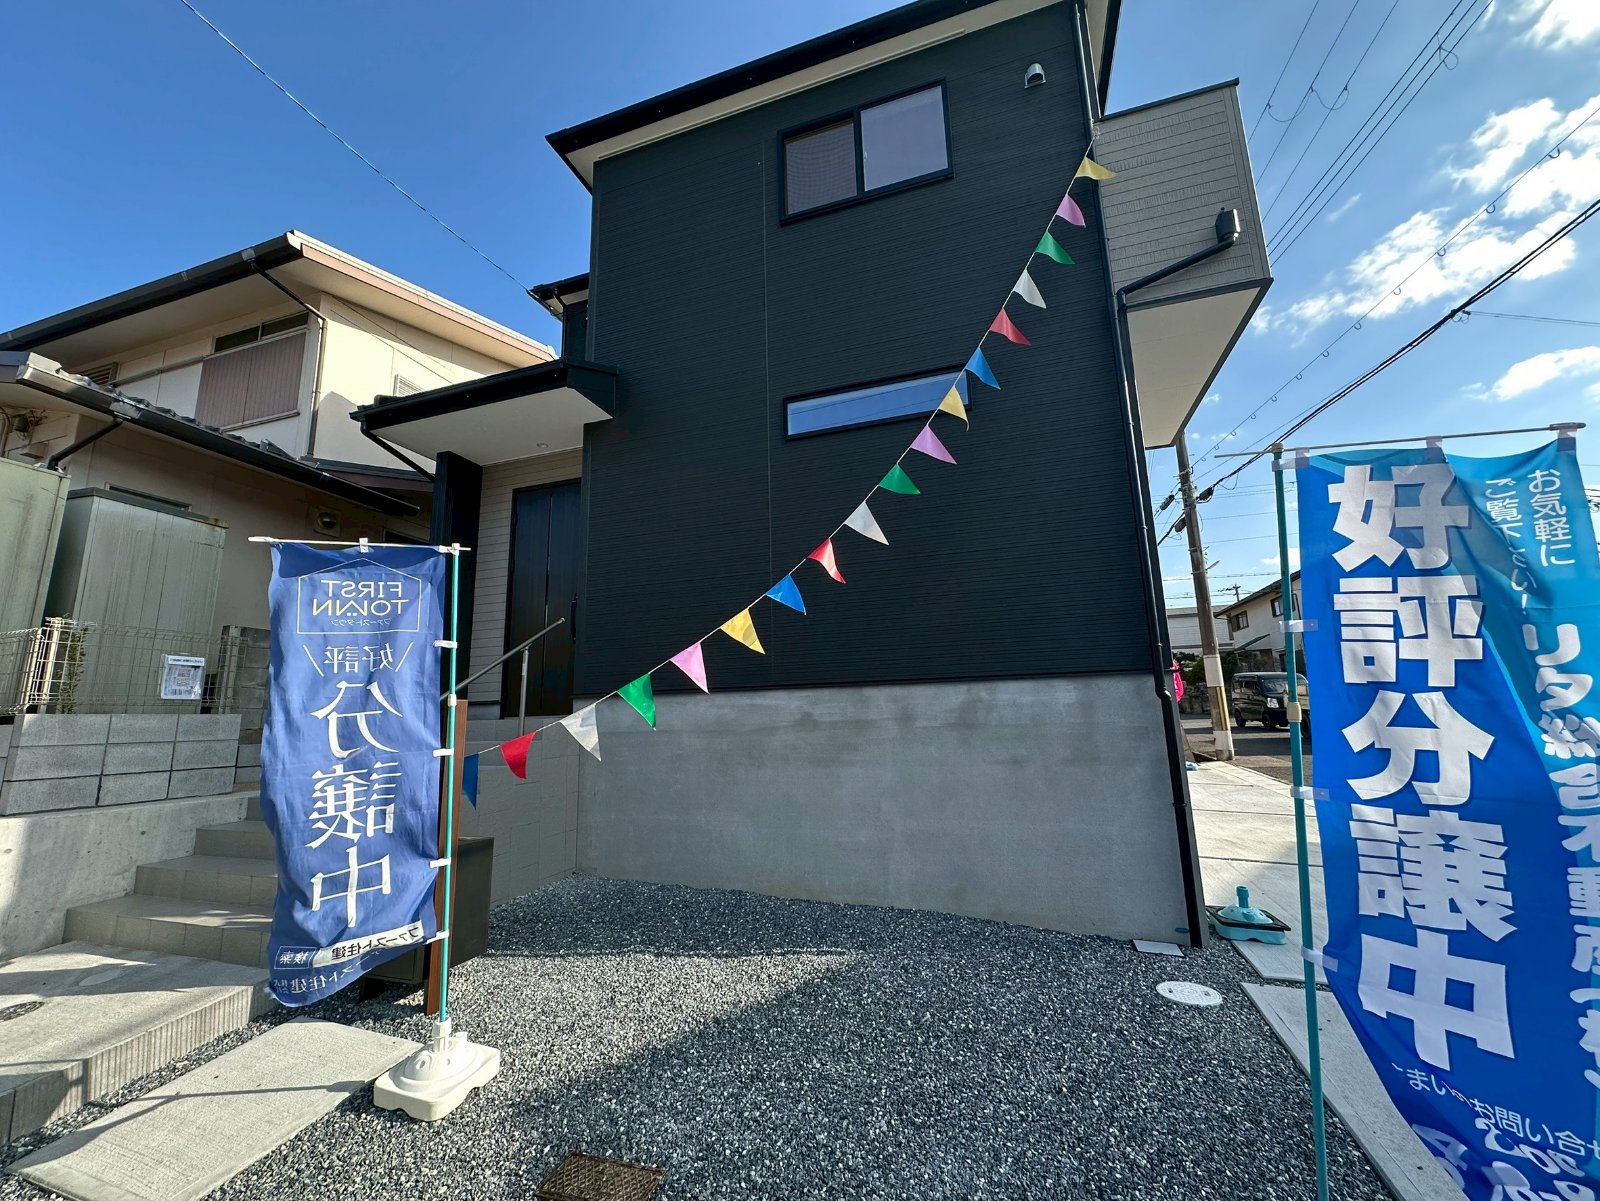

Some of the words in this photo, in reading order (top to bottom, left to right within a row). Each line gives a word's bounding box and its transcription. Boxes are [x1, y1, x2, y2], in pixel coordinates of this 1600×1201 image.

[1527, 468, 1576, 567] お気軽に
[1327, 463, 1518, 1071] 好評分譲中
